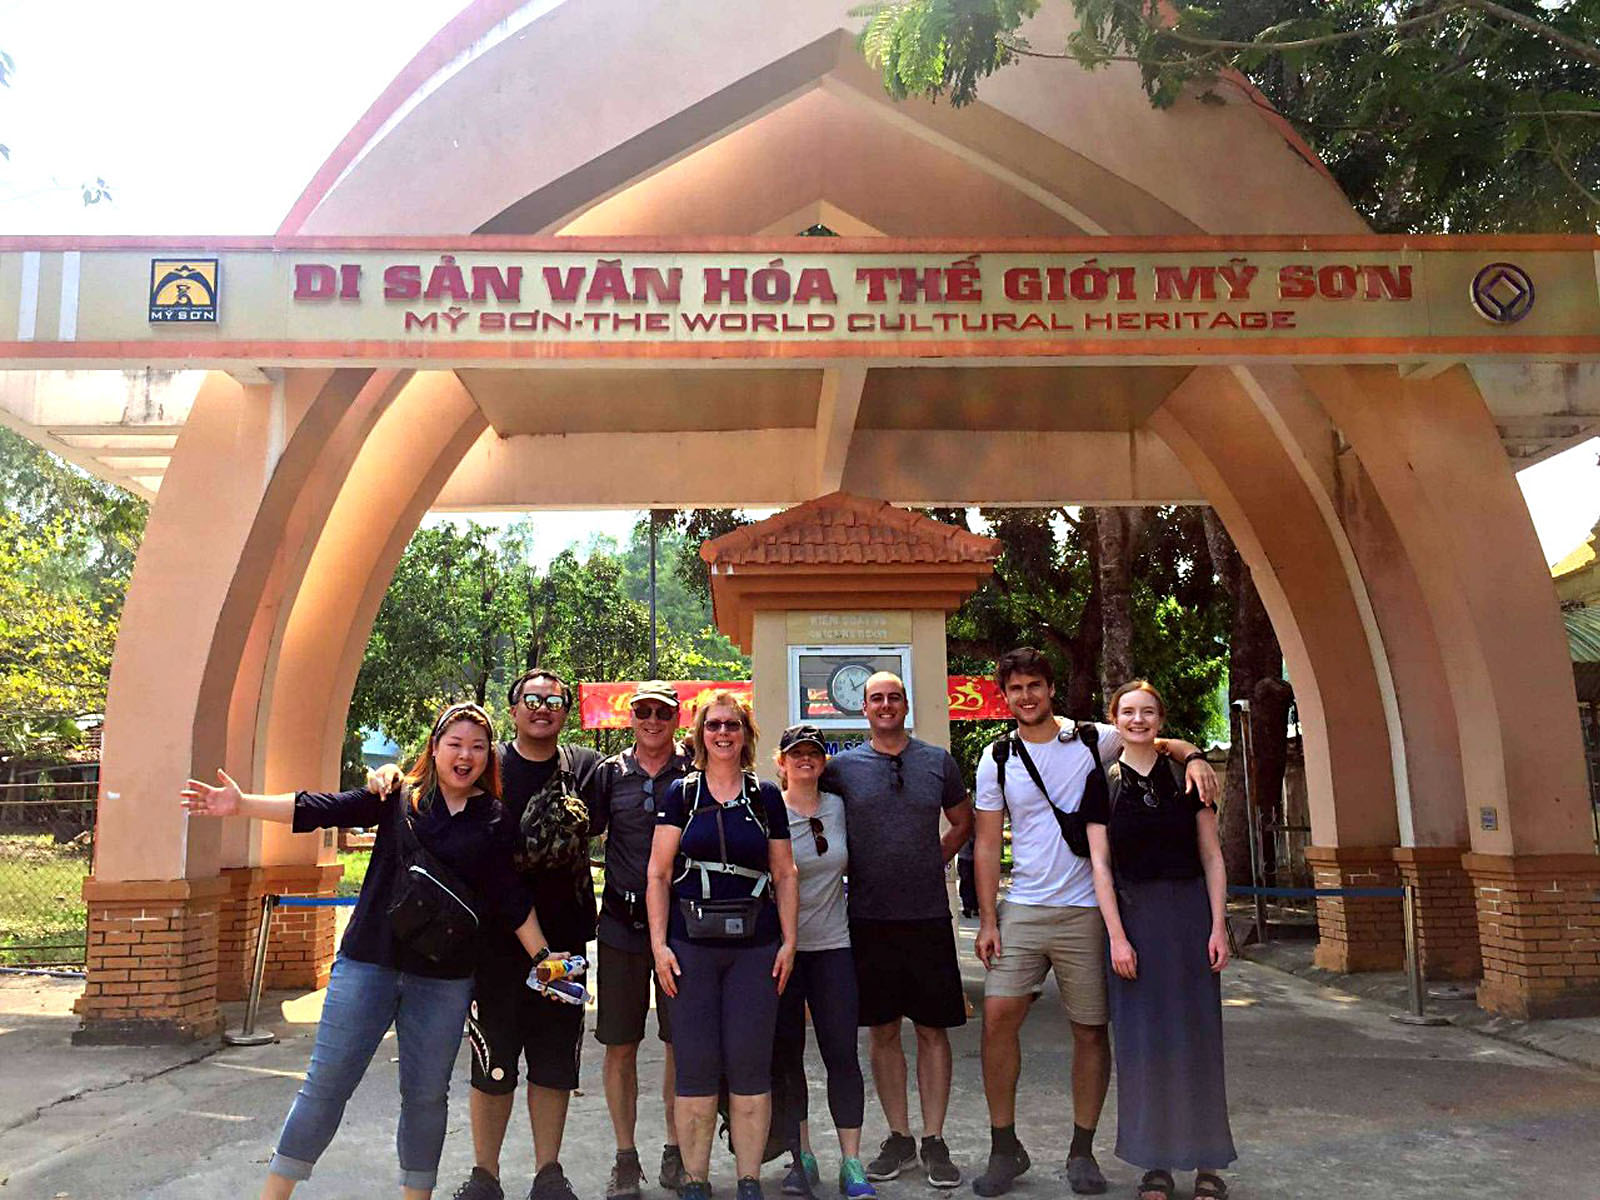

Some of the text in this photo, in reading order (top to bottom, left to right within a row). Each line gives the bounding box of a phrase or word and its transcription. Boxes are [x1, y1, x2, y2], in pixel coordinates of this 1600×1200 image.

[294, 255, 1413, 303] DI SẢN VĂN HÓA THẾ GIỚI MỸ SƠN
[405, 307, 469, 332] MỸ
[680, 312, 835, 332] WORLD
[847, 312, 1073, 332] CULTURAL
[1085, 311, 1296, 331] HERITAGE
